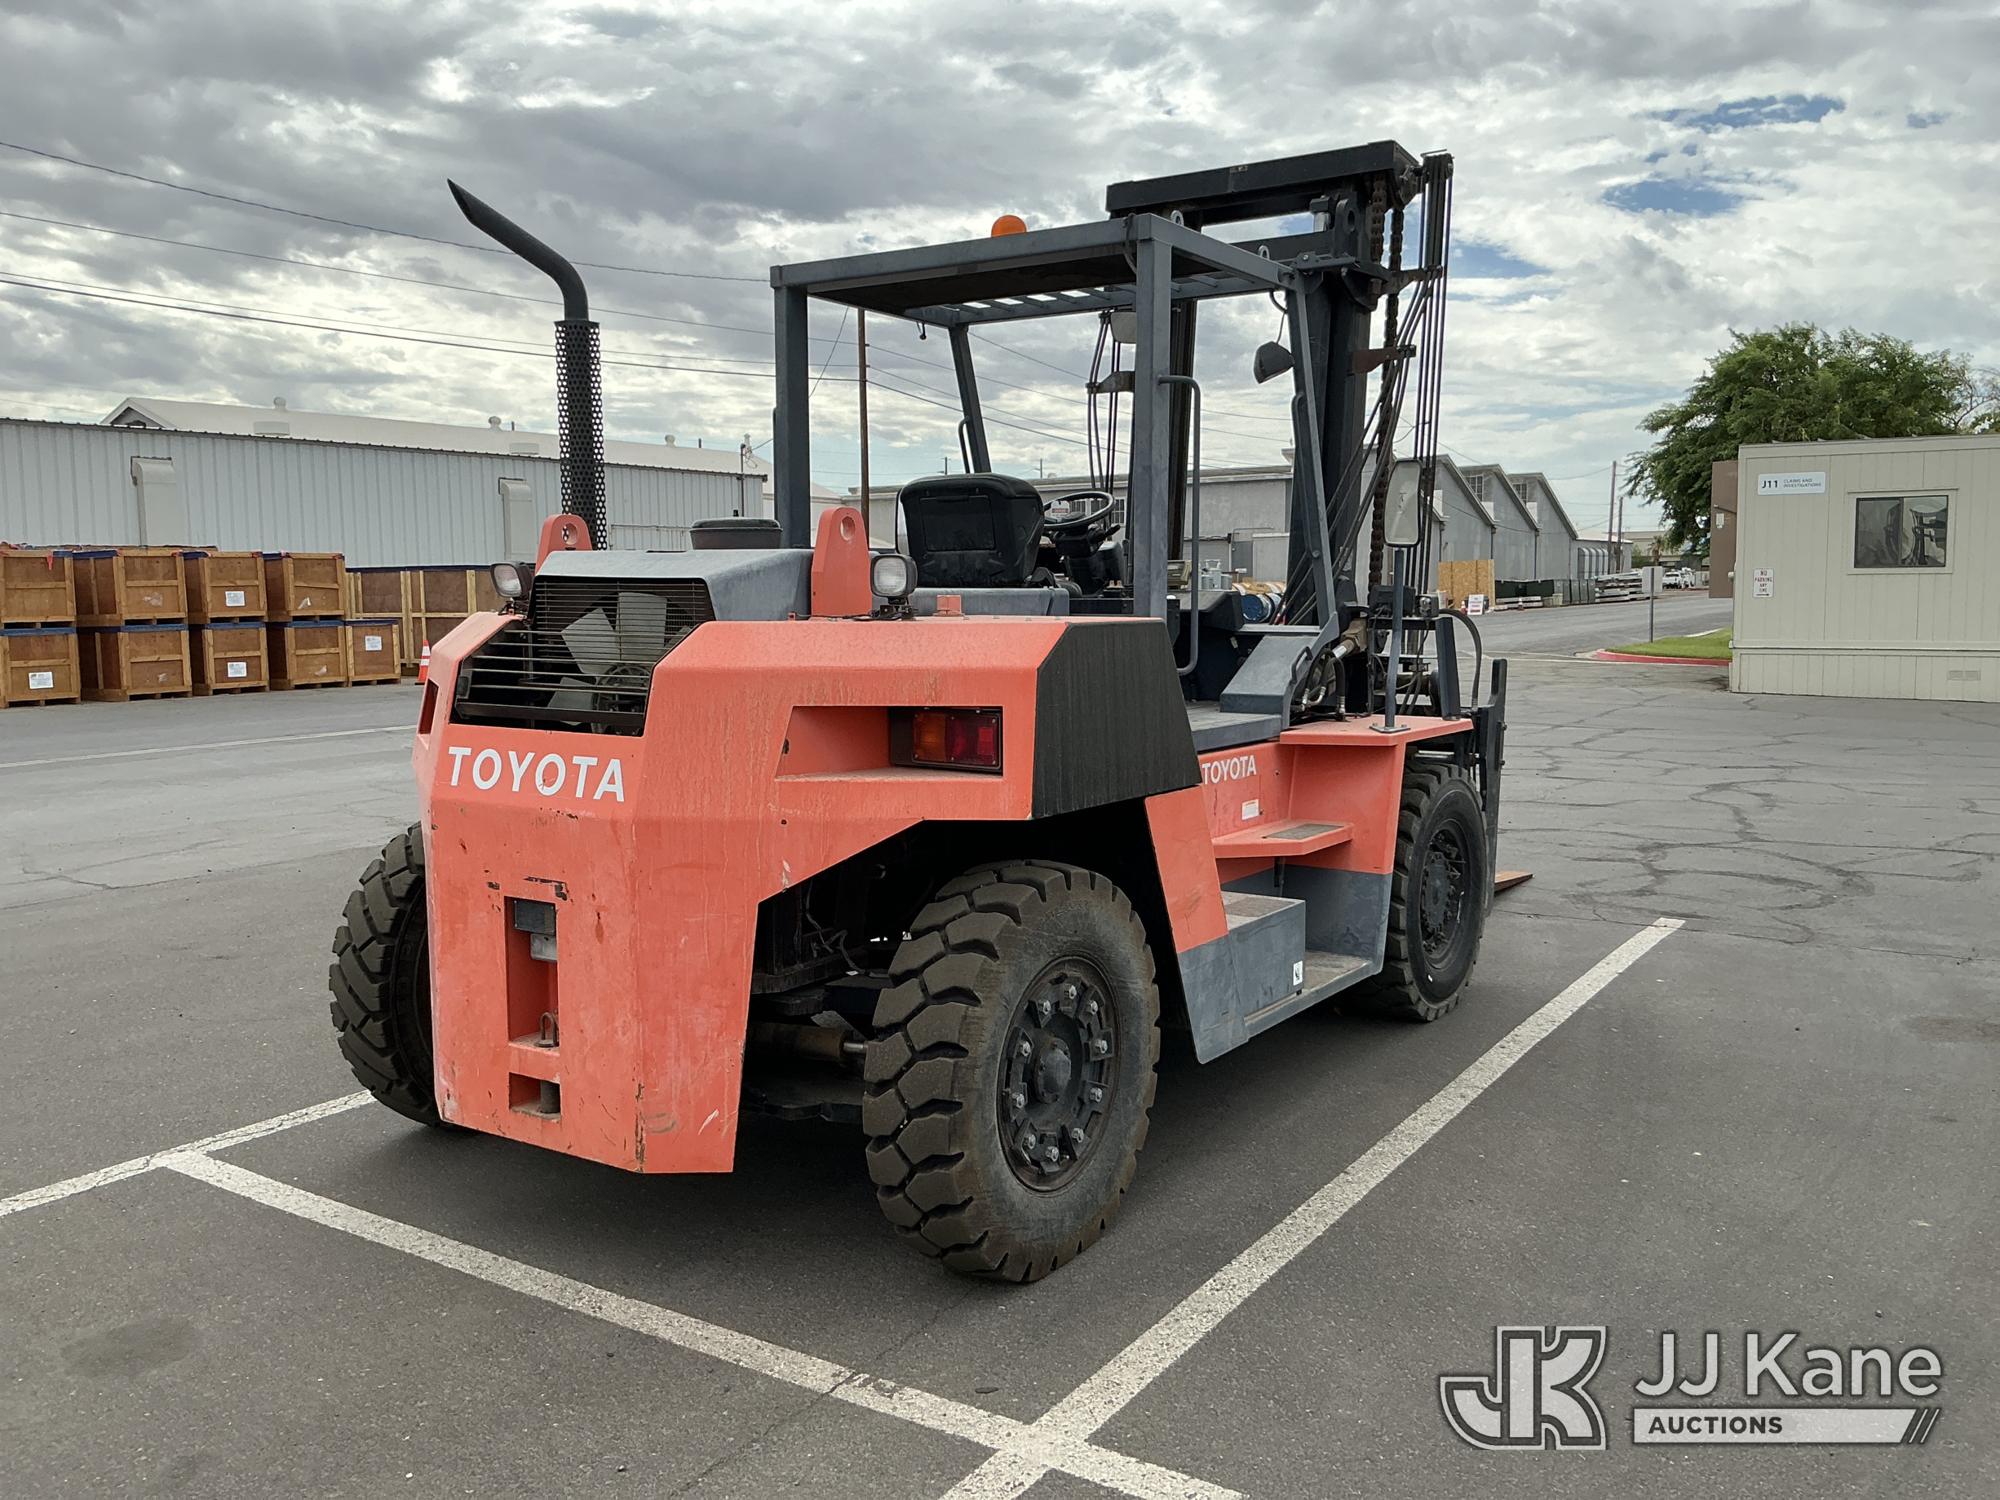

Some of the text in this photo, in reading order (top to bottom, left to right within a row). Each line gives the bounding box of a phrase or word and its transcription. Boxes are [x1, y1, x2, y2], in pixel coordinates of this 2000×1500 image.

[1762, 479, 1778, 489] J11
[448, 746, 625, 803] TOYOTA
[1201, 754, 1257, 785] TOYOTA
